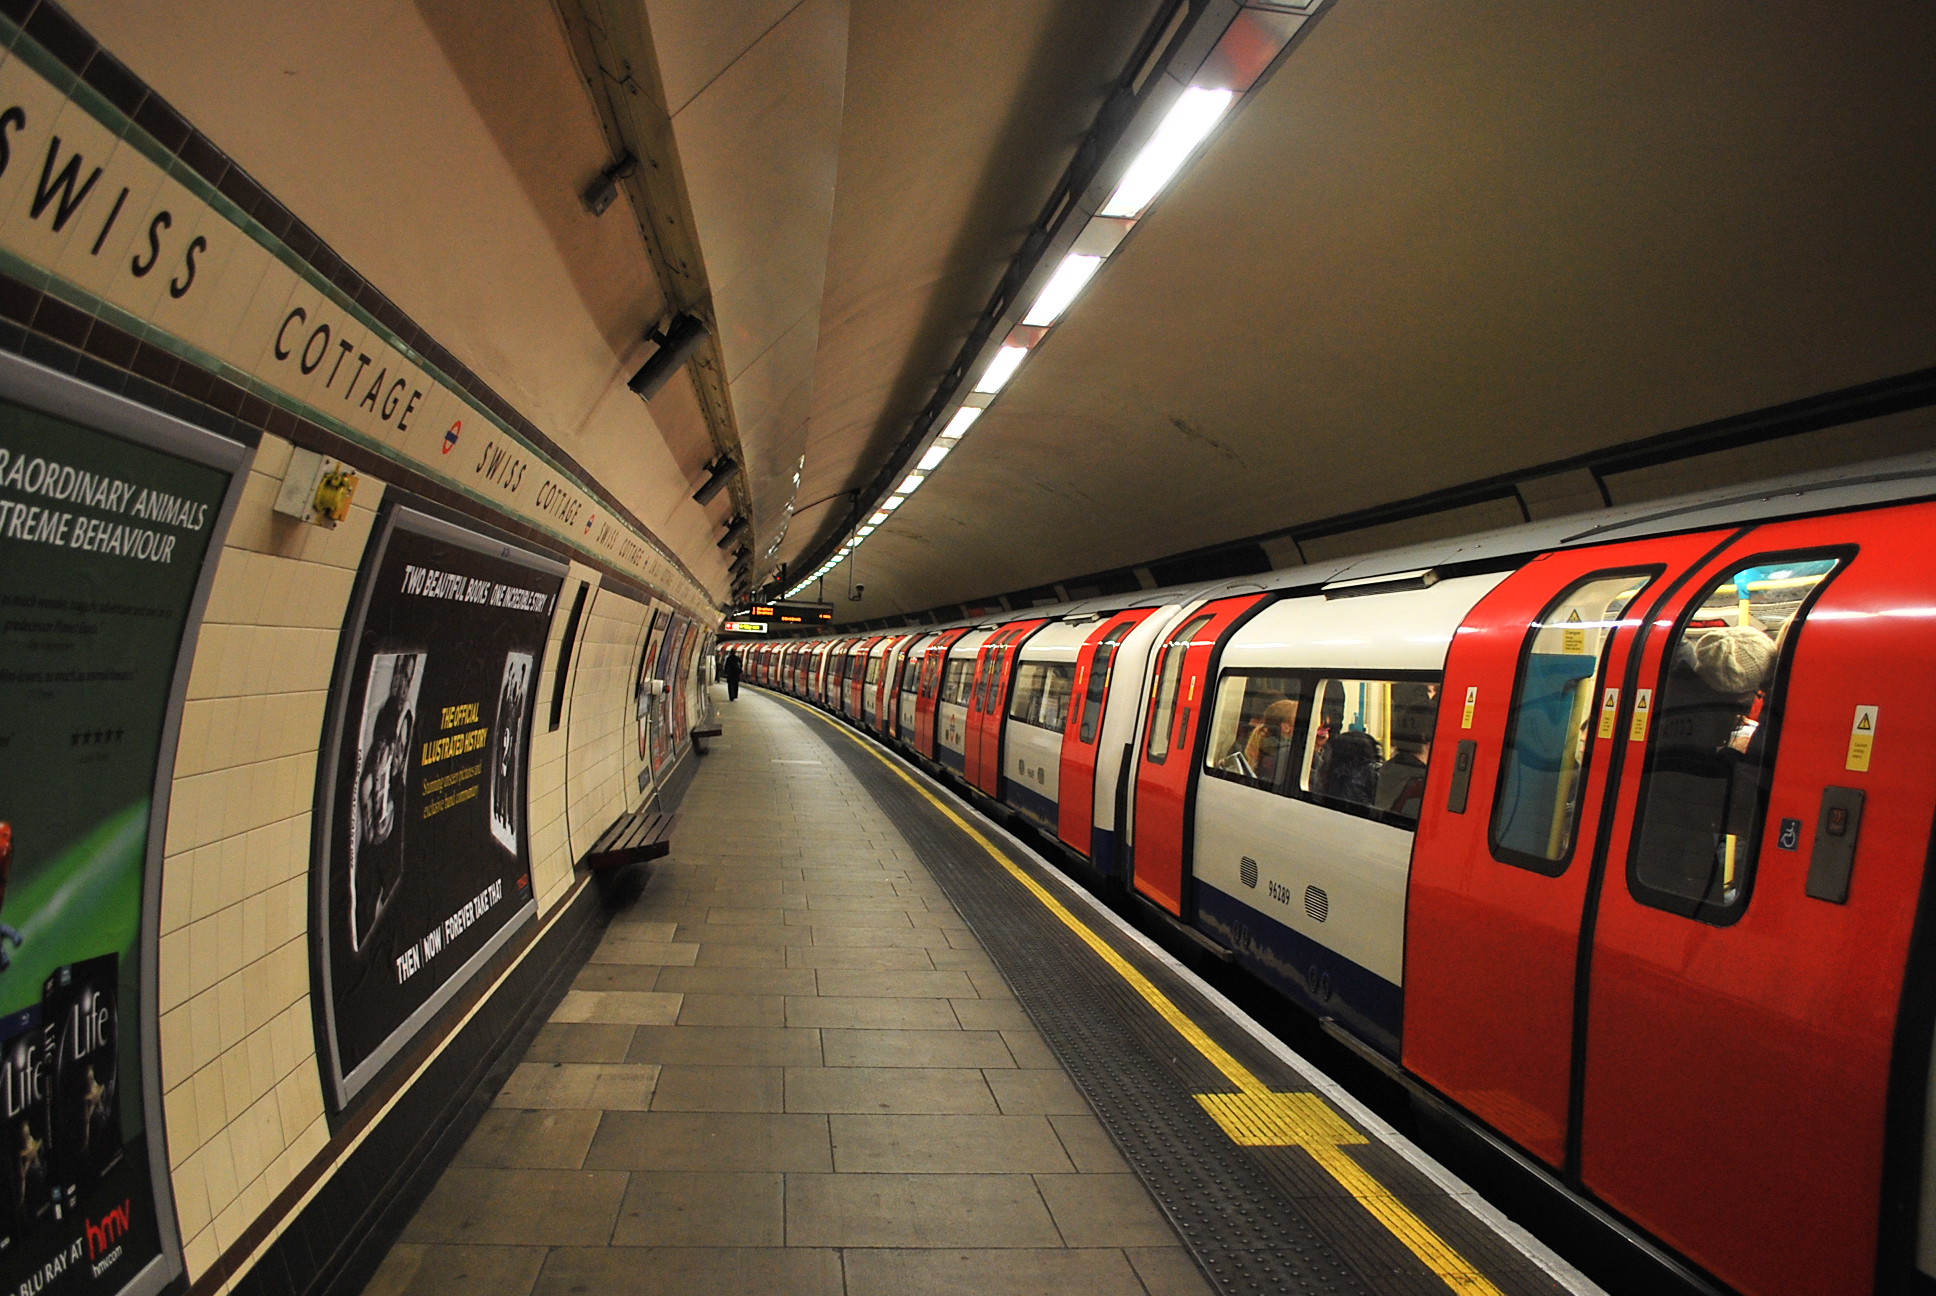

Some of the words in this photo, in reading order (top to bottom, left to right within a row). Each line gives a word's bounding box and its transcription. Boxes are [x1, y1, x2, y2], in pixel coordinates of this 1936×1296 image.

[274, 307, 423, 431] COTTAGE
[131, 488, 208, 531] ANIMALS
[475, 442, 528, 493] SWISS
[535, 480, 582, 526] COTTAGE
[70, 515, 176, 564] BEHAVIOUR
[401, 564, 427, 596] TWO
[422, 569, 468, 602] BEAUTIFUL
[464, 578, 491, 605] BOOKS
[490, 583, 507, 607] ONE
[502, 586, 533, 611] INCREDIBLE
[530, 590, 549, 613] STORY
[440, 706, 456, 730] THE
[454, 702, 480, 727] OFFICIAL
[421, 733, 465, 766] ILLUSTRATED
[463, 727, 489, 753] HISTORY
[1267, 880, 1291, 906] 96289
[396, 943, 421, 985] THEN
[423, 925, 442, 963] NOW
[444, 900, 476, 945] FOREVER
[472, 888, 490, 919] TAKE
[487, 878, 503, 907] THAT
[73, 989, 109, 1061] Life
[6, 1044, 43, 1118] Life
[85, 1199, 131, 1261] hmv
[19, 1269, 44, 1296] BLU
[45, 1249, 67, 1283] RAY
[71, 1236, 83, 1264] AT
